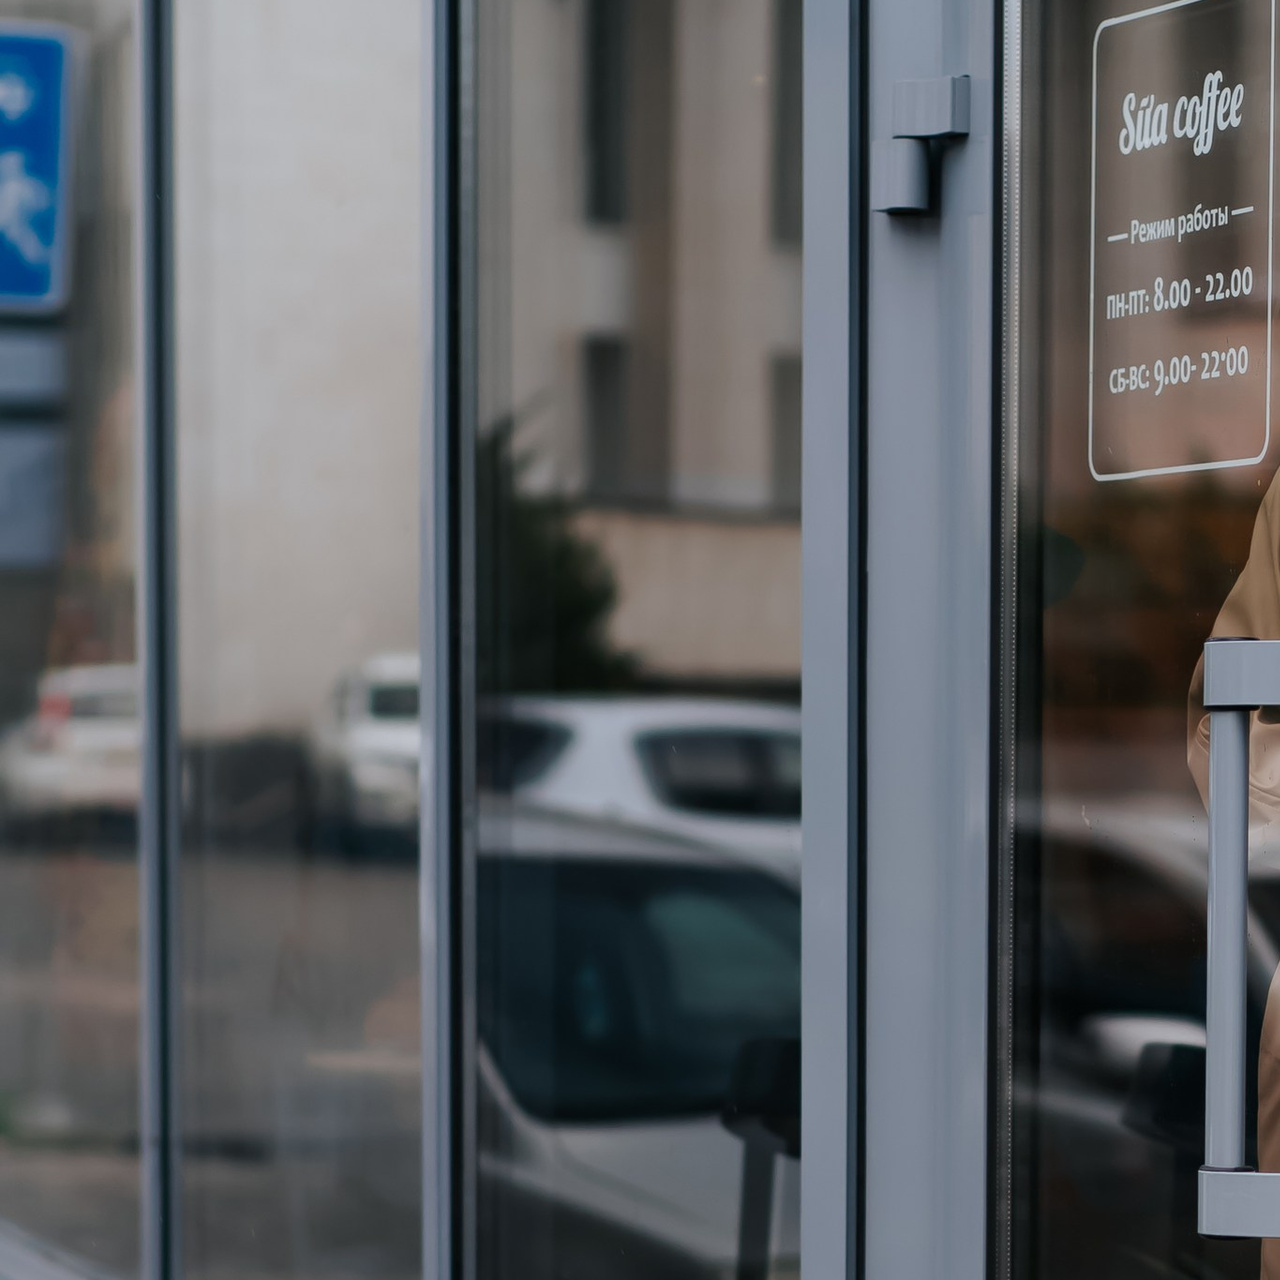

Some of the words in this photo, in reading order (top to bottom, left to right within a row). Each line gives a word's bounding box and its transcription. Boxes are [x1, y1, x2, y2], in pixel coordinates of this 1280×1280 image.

[1173, 70, 1244, 156] coffee
[1130, 219, 1175, 244] Режим
[1177, 203, 1228, 243] работы
[1153, 276, 1191, 311] 8.00
[1205, 266, 1253, 302] 22.00
